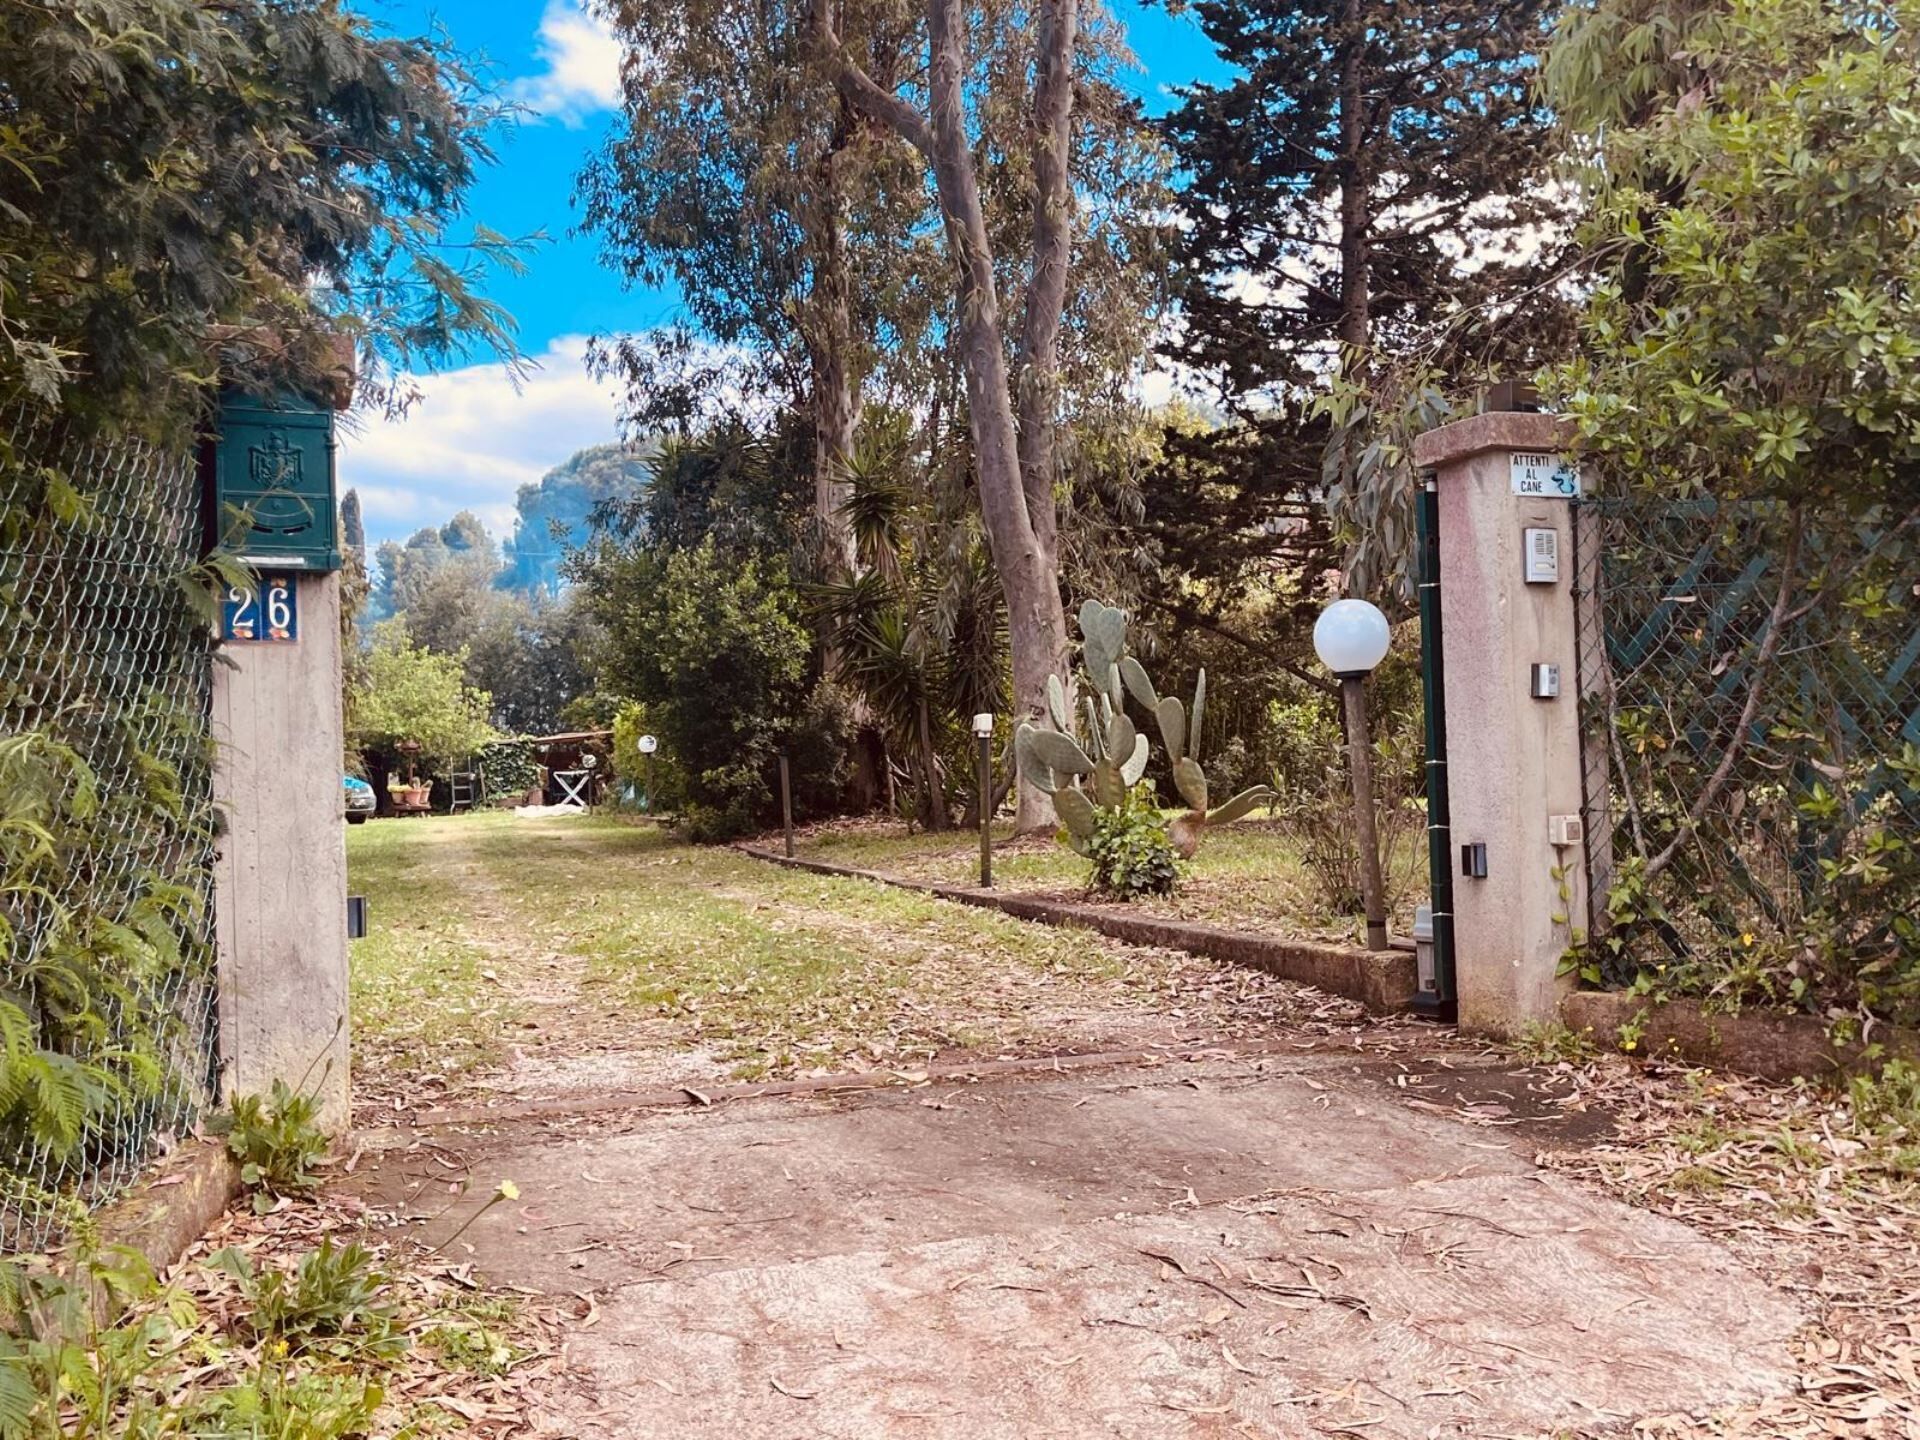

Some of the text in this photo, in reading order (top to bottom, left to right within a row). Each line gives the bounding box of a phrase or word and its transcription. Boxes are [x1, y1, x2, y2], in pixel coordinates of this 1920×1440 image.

[1513, 455, 1549, 467] ATTENTI
[1526, 468, 1537, 480] AL
[1521, 481, 1542, 493] CANE
[229, 587, 290, 628] 26
